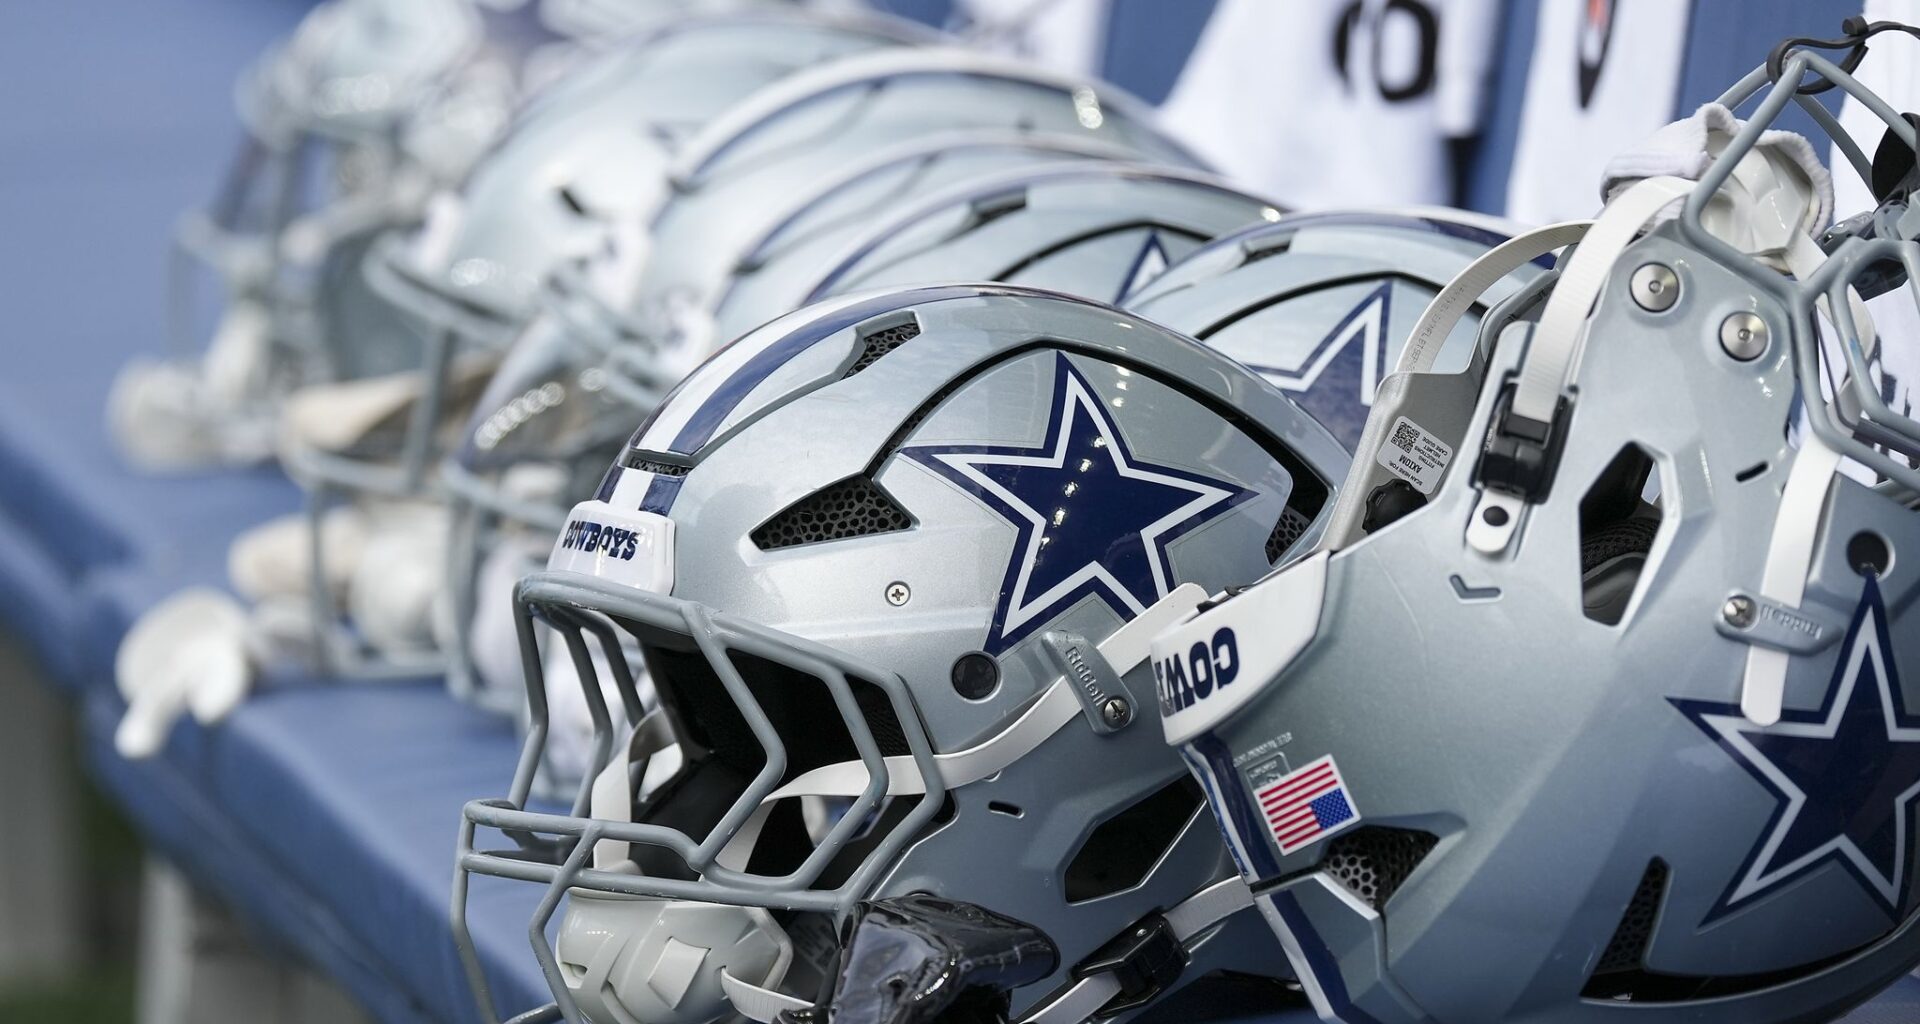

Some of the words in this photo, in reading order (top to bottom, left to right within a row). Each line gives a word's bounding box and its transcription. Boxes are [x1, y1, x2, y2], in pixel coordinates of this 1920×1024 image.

[1414, 445, 1444, 468] INSTRUCTIONS
[1418, 455, 1434, 468] FITTING
[1423, 445, 1441, 458] HELMET
[1398, 455, 1422, 473] AXIOM
[562, 521, 640, 561] COWBOYS
[1065, 646, 1107, 706] Riddell
